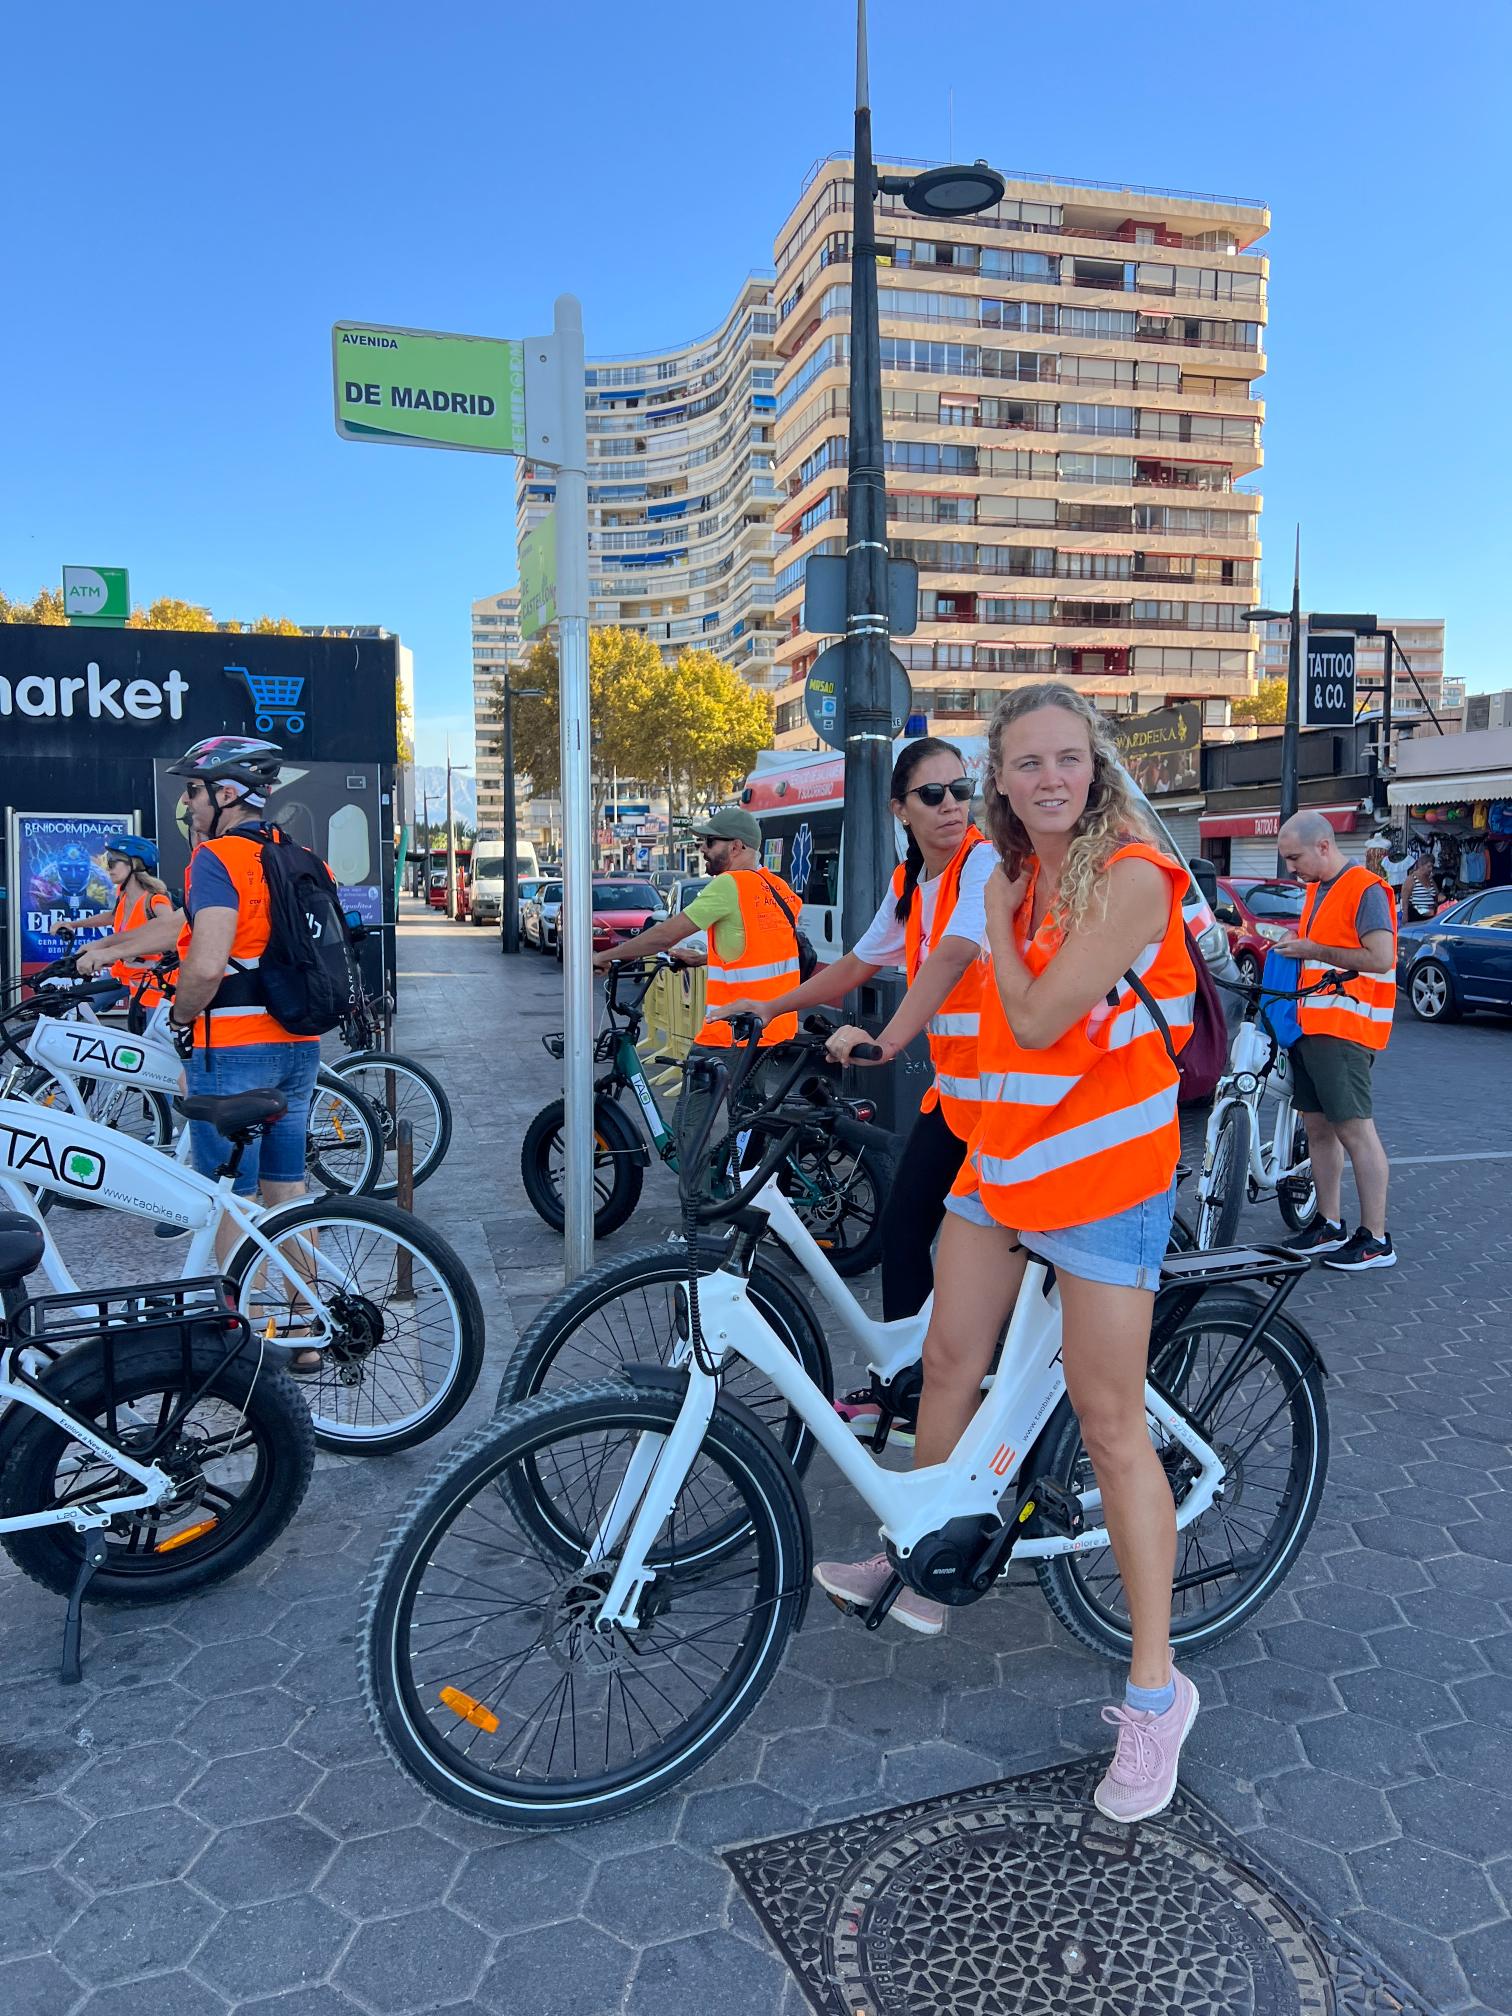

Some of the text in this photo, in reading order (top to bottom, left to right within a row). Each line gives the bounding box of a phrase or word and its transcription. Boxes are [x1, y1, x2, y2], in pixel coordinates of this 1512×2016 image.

[342, 333, 398, 349] AVENIDA
[345, 382, 495, 416] DE MADRID
[69, 586, 100, 597] ATM
[1308, 653, 1353, 678] TATTOO
[1314, 684, 1346, 709] & CO.
[1255, 819, 1272, 834] TATTOO
[66, 1032, 145, 1074] TAO
[634, 1074, 651, 1105] TAO
[0, 1123, 106, 1191] TAO
[1063, 1539, 1100, 1551] Explore
